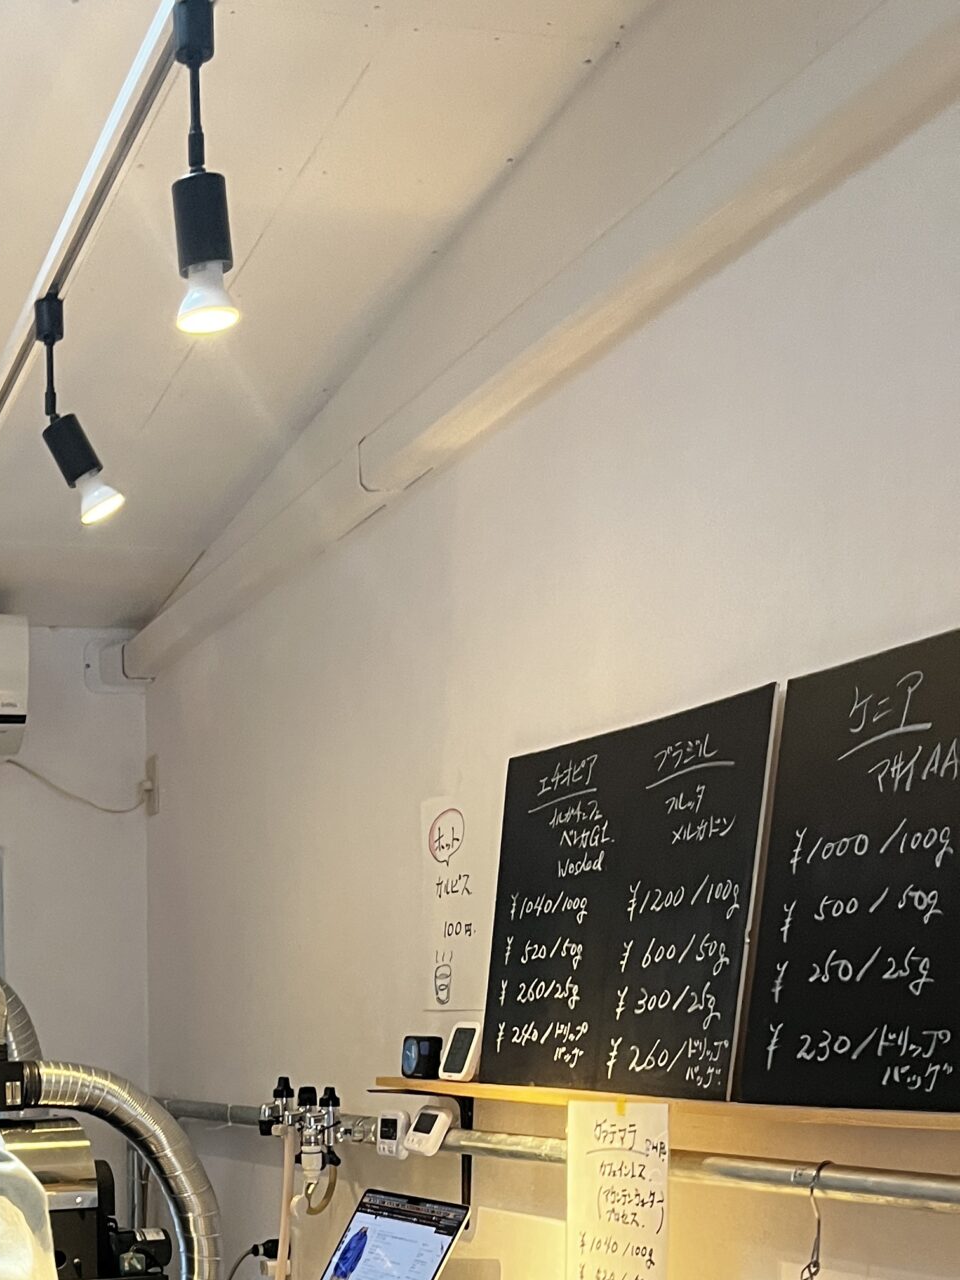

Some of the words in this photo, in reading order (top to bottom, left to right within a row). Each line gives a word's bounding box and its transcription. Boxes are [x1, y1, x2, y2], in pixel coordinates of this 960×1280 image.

[846, 671, 924, 733] ケニア
[654, 732, 720, 772] ブラジル
[537, 754, 599, 797] エチオピア
[434, 826, 460, 852] ホット
